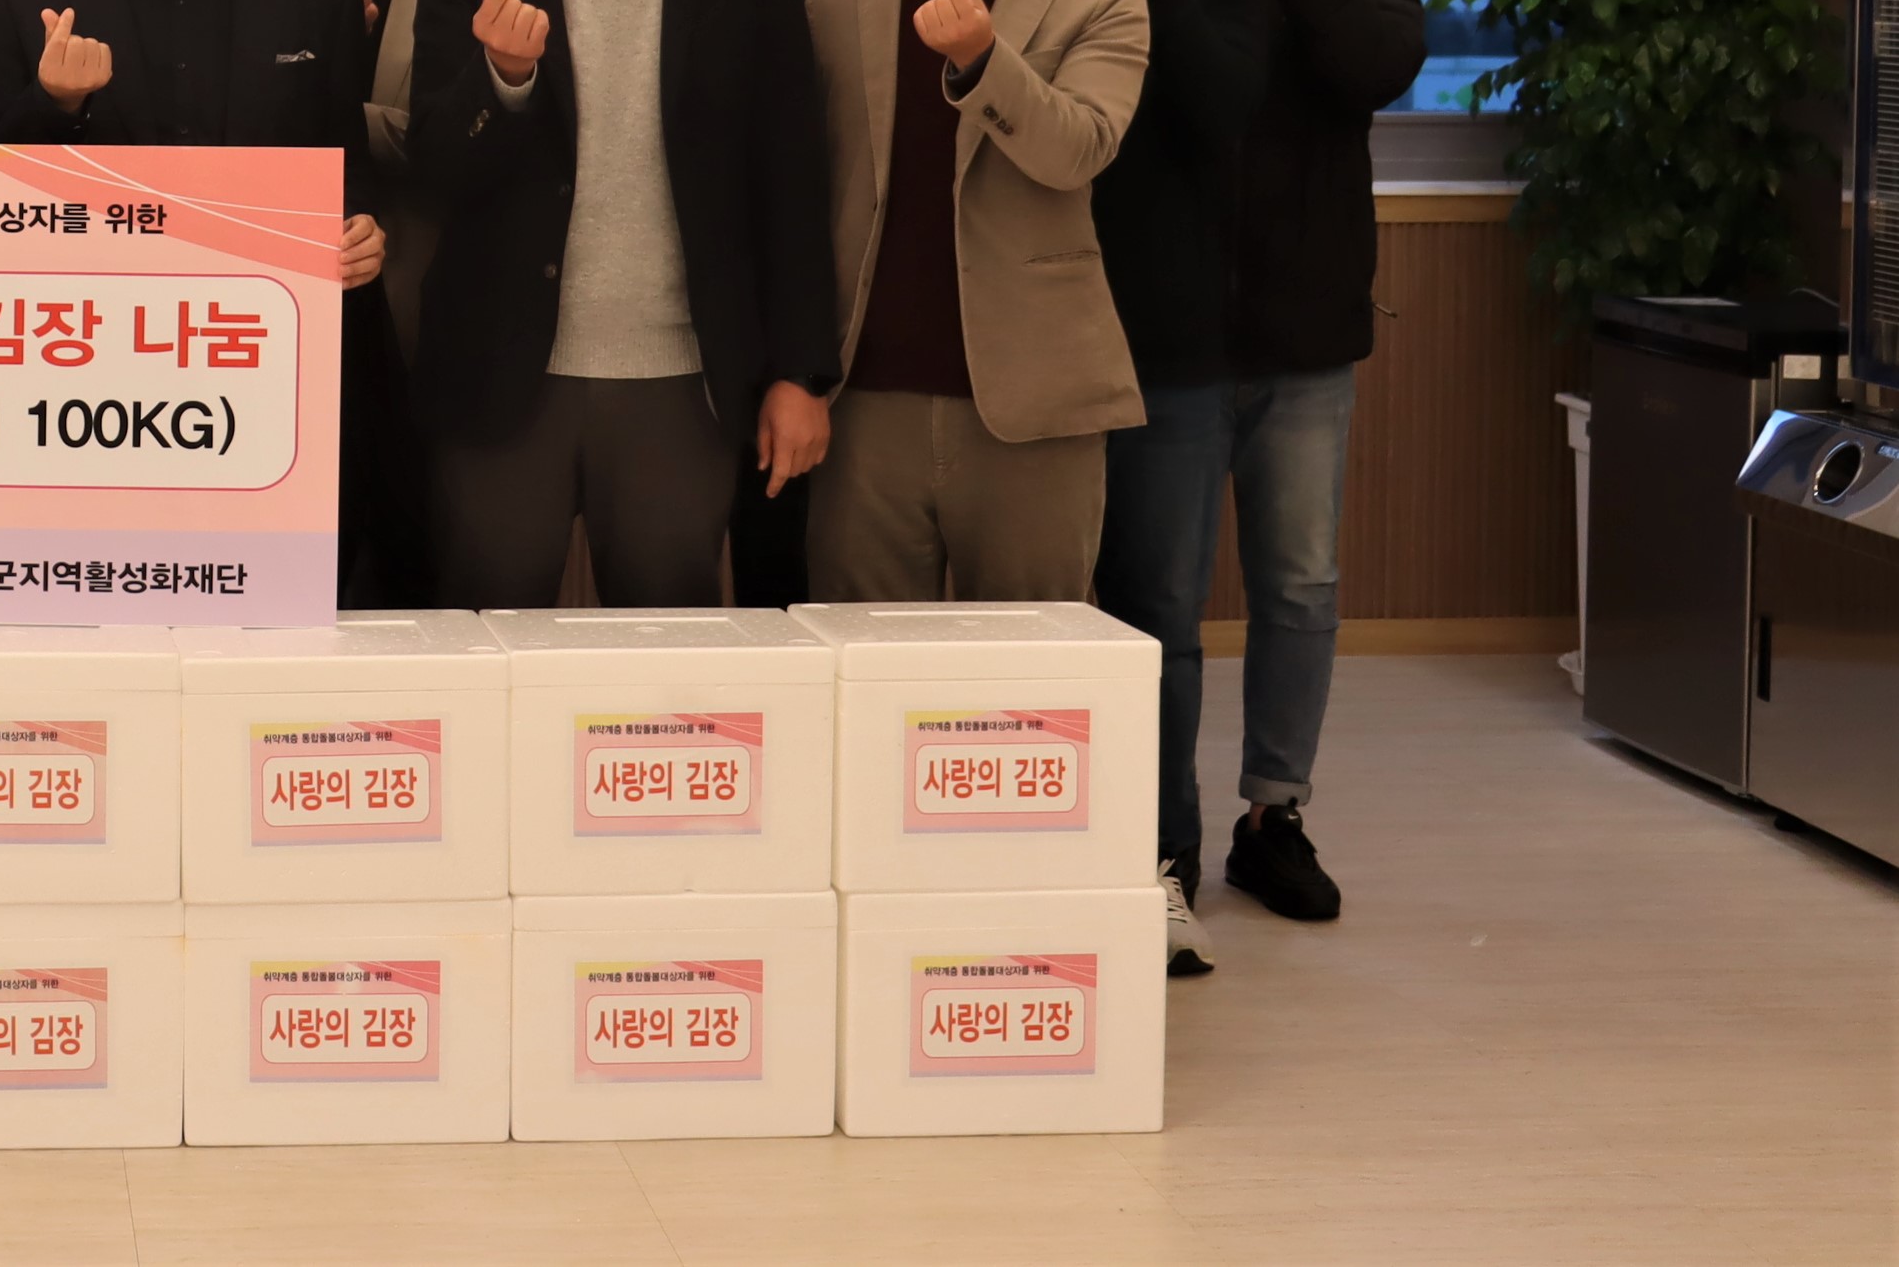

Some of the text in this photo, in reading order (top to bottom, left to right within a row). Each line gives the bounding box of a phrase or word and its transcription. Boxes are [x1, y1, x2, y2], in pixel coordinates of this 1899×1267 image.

[105, 204, 167, 234] 위한
[134, 301, 267, 368] 나눔
[28, 396, 235, 455] 100KG)
[29, 769, 82, 809] 김장
[271, 768, 417, 811] 사랑의 김장
[594, 760, 738, 802] 사랑의 김장
[923, 757, 1065, 798] 사랑의 김장
[31, 1015, 83, 1055] 김장
[270, 1008, 415, 1048] 사랑의 김장
[595, 1007, 738, 1048] 사랑의 김장
[930, 1001, 1072, 1042] 사랑의 김장
